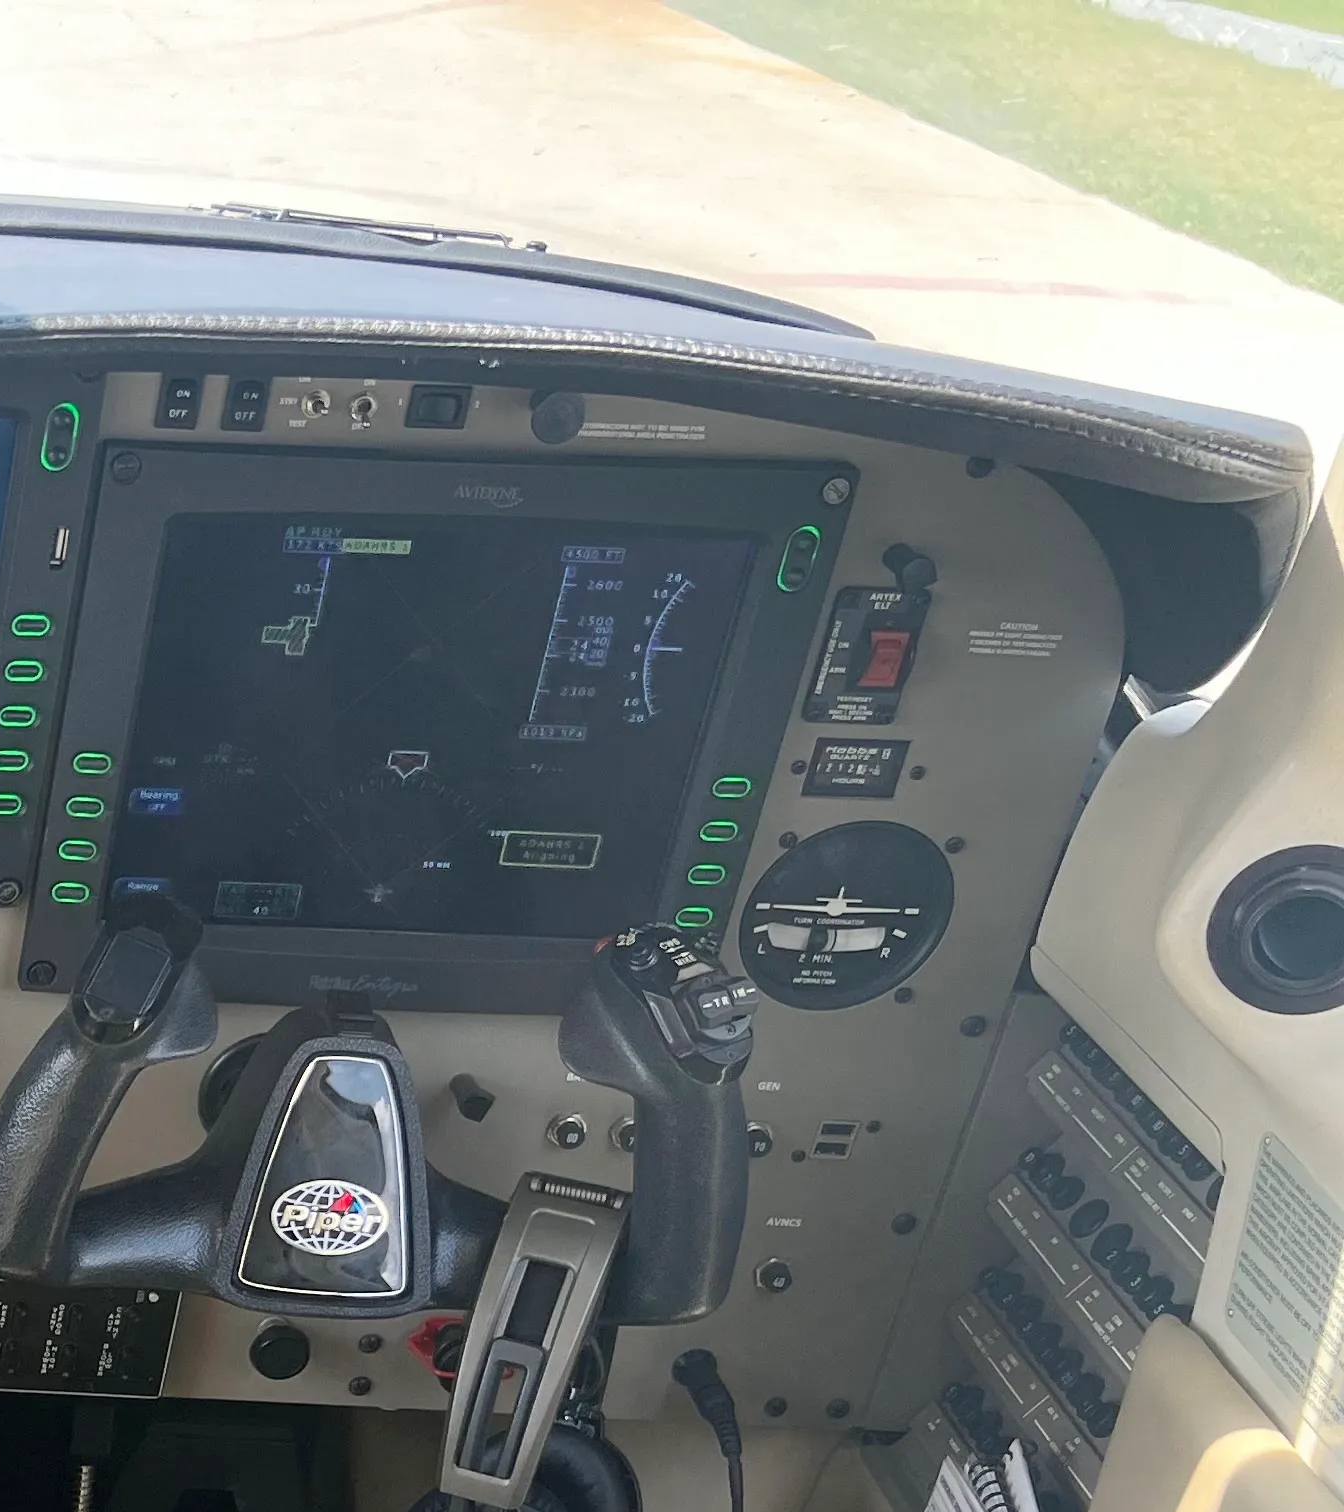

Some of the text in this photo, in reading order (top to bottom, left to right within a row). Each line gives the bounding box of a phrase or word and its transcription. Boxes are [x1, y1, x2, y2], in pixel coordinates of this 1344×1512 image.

[870, 593, 901, 601] ARTEX
[874, 602, 891, 610] ELT
[826, 746, 878, 754] Hobbs
[127, 882, 159, 891] Range
[794, 917, 865, 926] TURN COORDINATOR
[880, 947, 890, 958] R
[792, 977, 836, 985] INFORMATION
[757, 1081, 781, 1092] GEN
[280, 1204, 382, 1235] Piper
[766, 1218, 802, 1228] AVNCS
